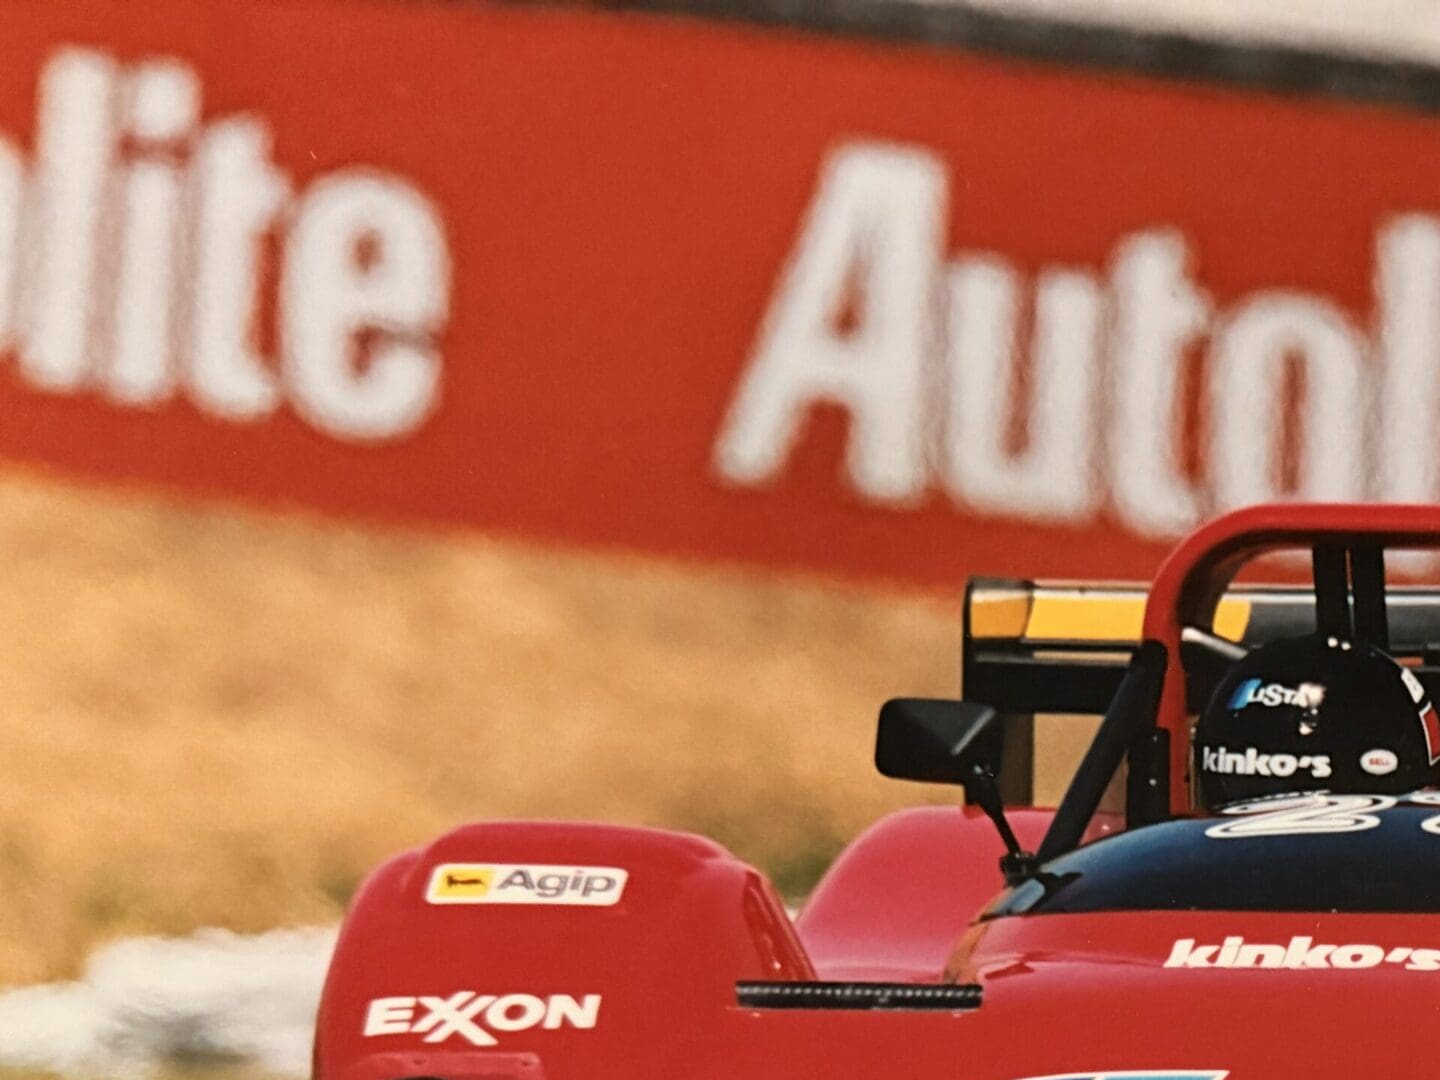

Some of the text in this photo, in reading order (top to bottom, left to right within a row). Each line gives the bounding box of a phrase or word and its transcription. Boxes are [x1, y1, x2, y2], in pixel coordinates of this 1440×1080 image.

[0, 45, 450, 445] lite
[1203, 746, 1332, 777] kinko's
[497, 870, 617, 897] Agip
[363, 991, 602, 1046] EXXON
